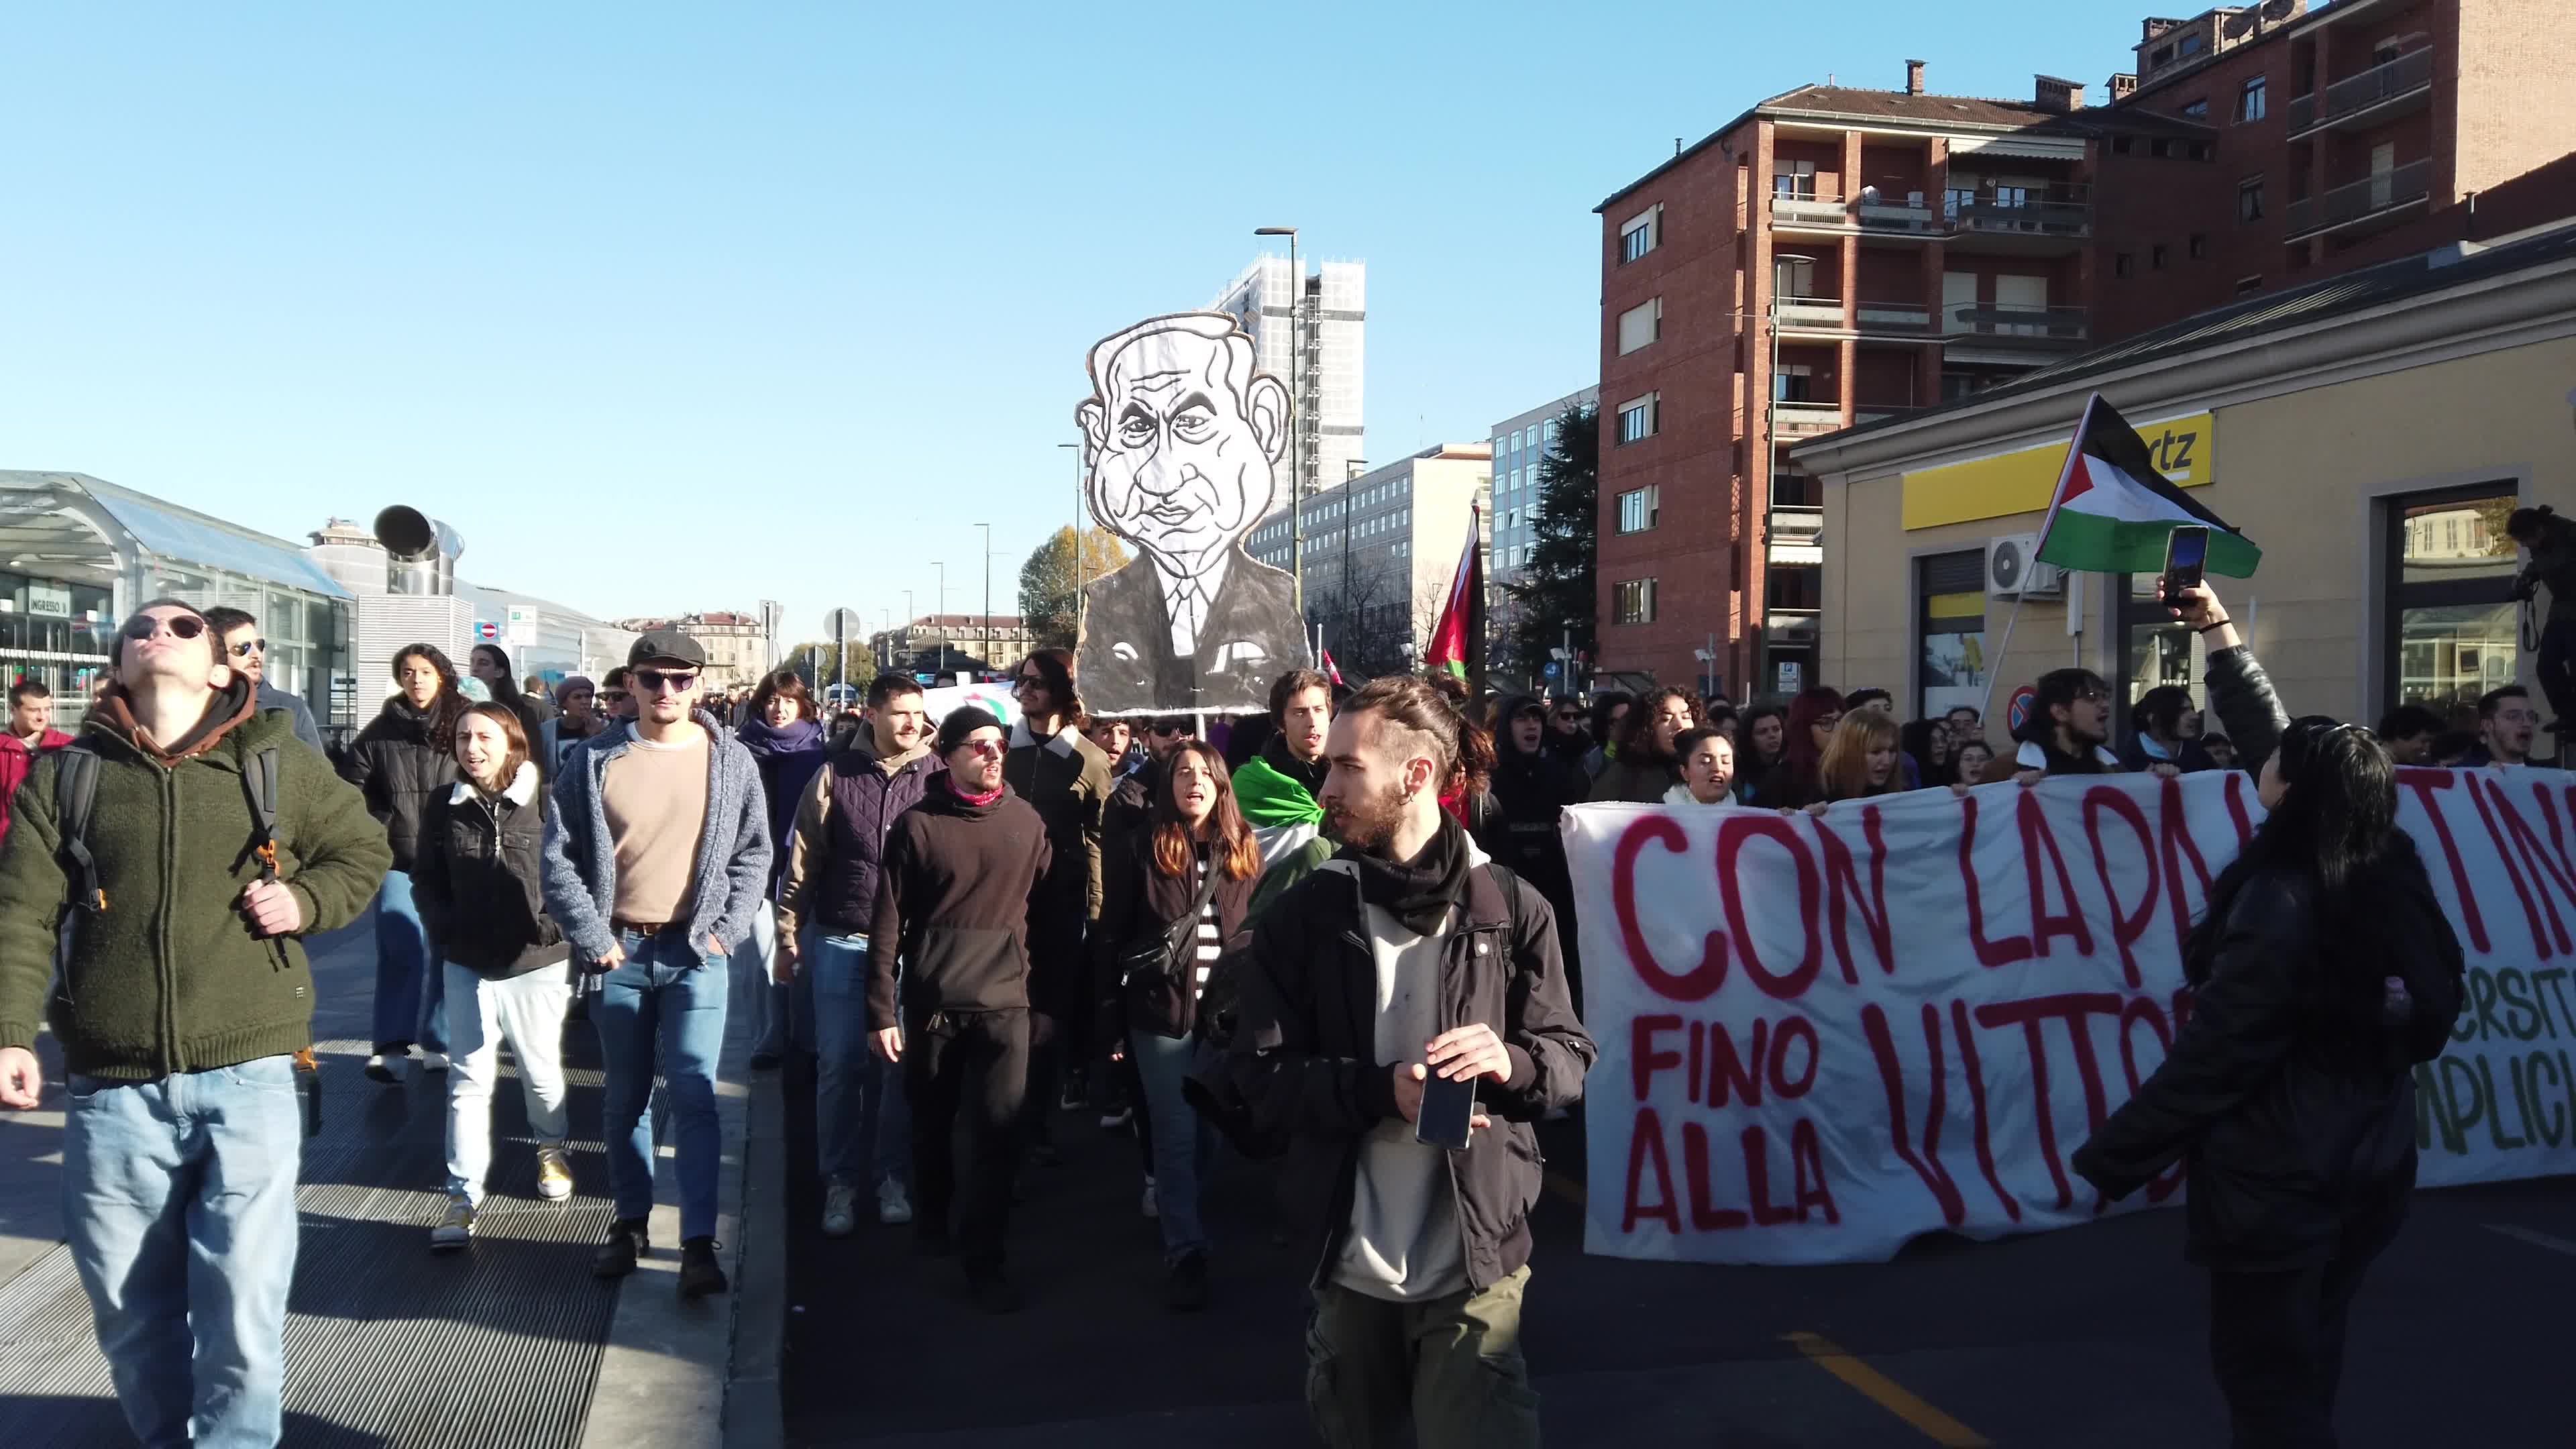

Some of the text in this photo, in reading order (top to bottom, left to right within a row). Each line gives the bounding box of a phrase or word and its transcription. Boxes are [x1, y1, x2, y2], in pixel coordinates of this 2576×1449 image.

[2149, 429, 2197, 470] rtz
[31, 598, 60, 612] INGRESSO
[1613, 805, 1894, 1001] CON
[1632, 1014, 1819, 1108] FINO
[1862, 989, 2195, 1226] VITTO
[1621, 1107, 1840, 1234] ALLA
